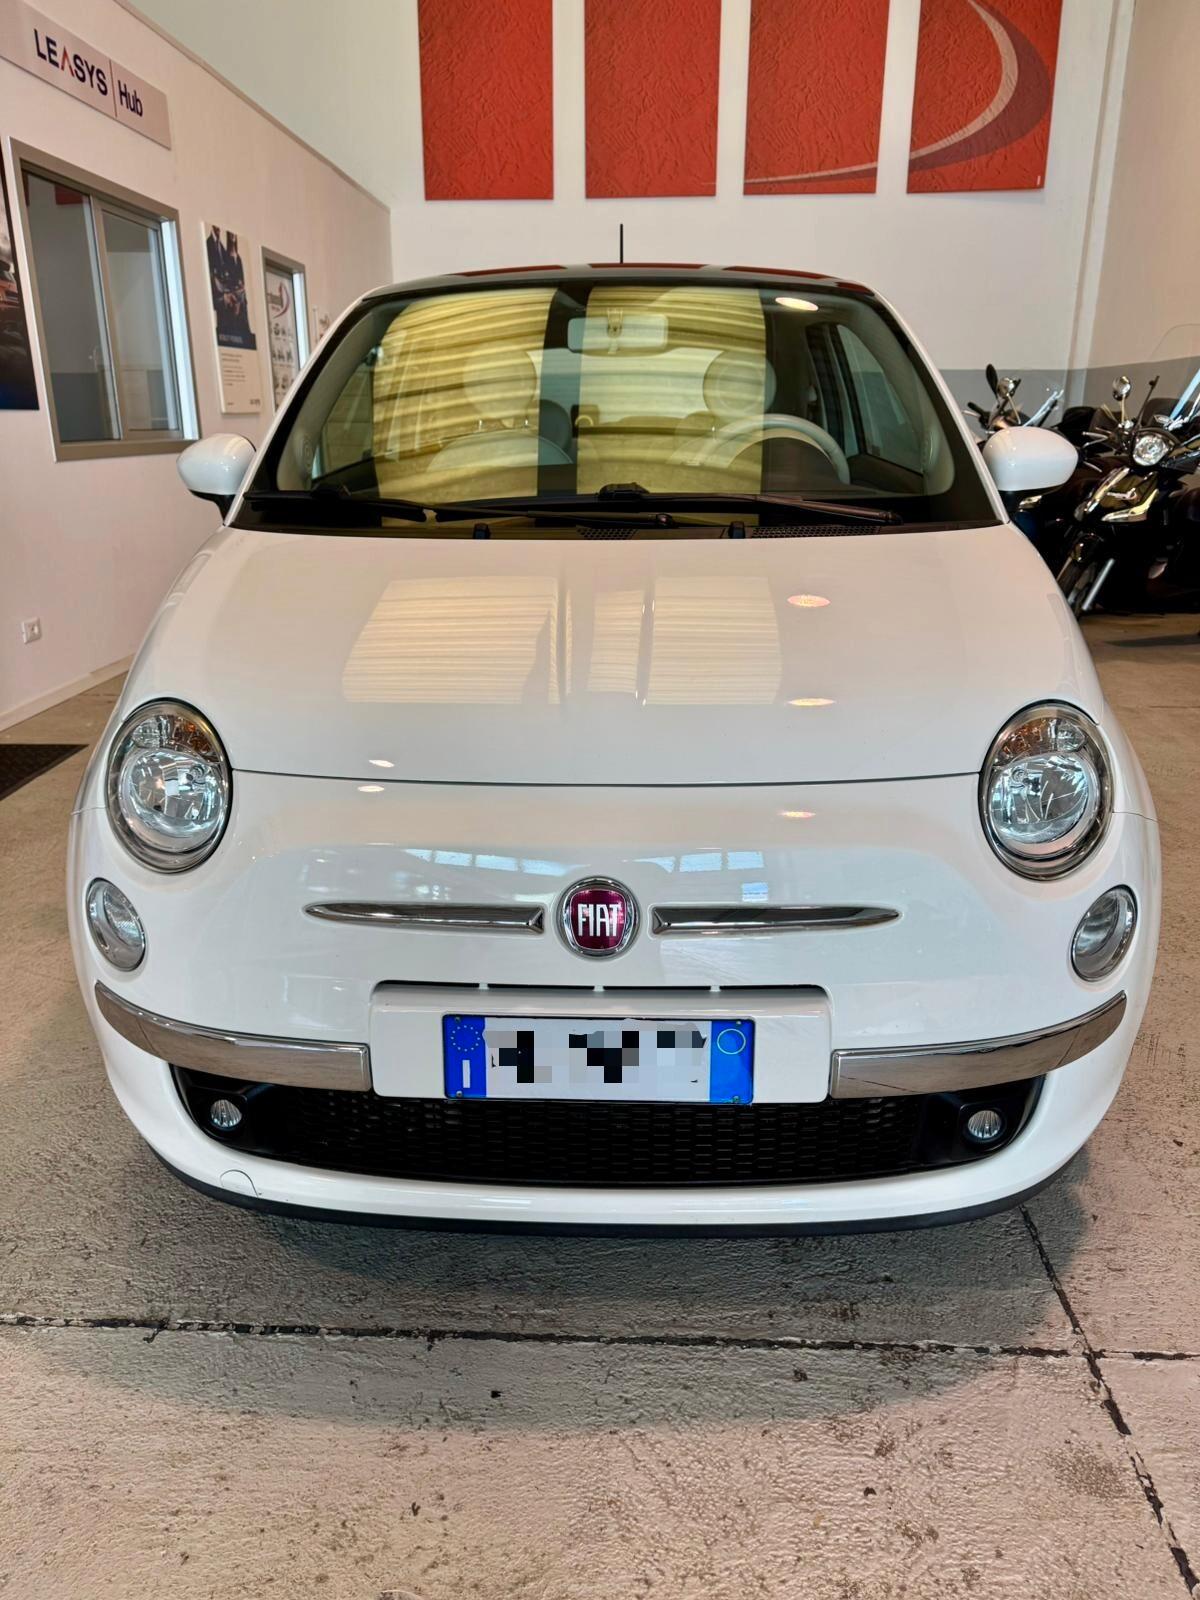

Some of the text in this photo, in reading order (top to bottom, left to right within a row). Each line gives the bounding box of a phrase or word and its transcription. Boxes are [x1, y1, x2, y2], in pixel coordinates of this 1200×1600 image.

[34, 29, 143, 117] LEASYS Hub
[578, 904, 621, 937] FIAT
